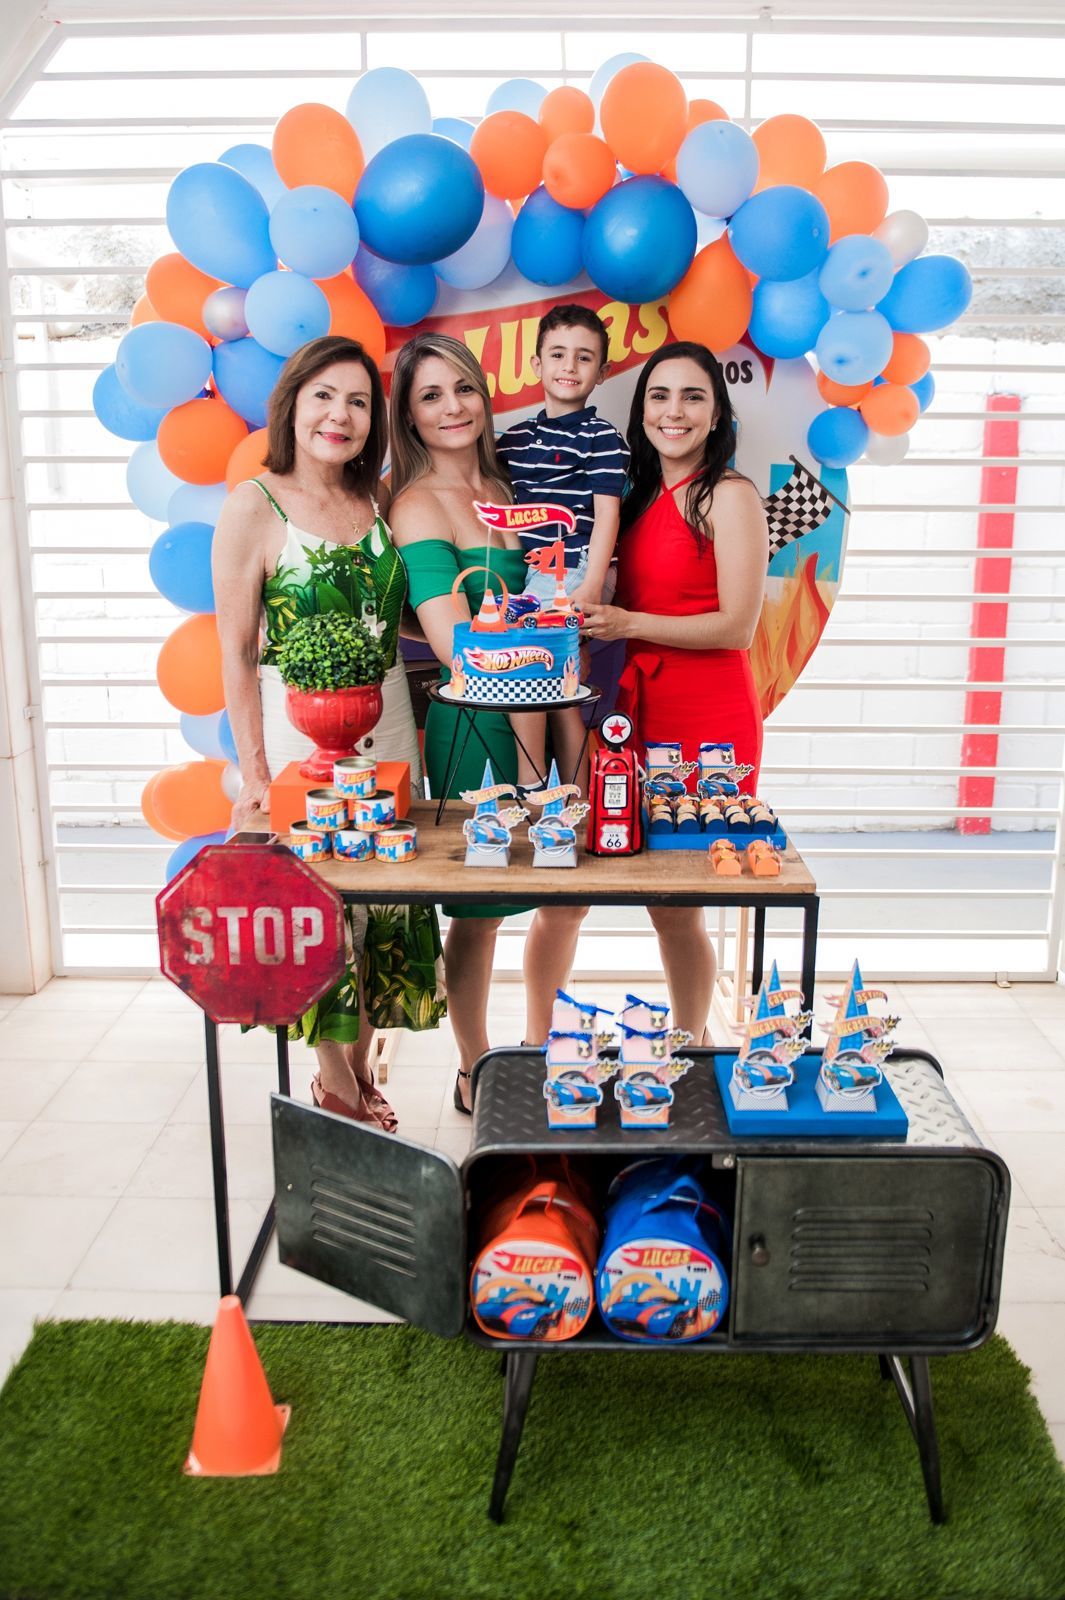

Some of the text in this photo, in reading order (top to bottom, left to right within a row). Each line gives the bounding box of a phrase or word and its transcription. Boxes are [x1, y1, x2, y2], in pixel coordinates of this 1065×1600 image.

[463, 300, 669, 397] Luas
[504, 508, 548, 526] Lucas
[606, 838, 622, 848] 66
[181, 906, 325, 966] STOP
